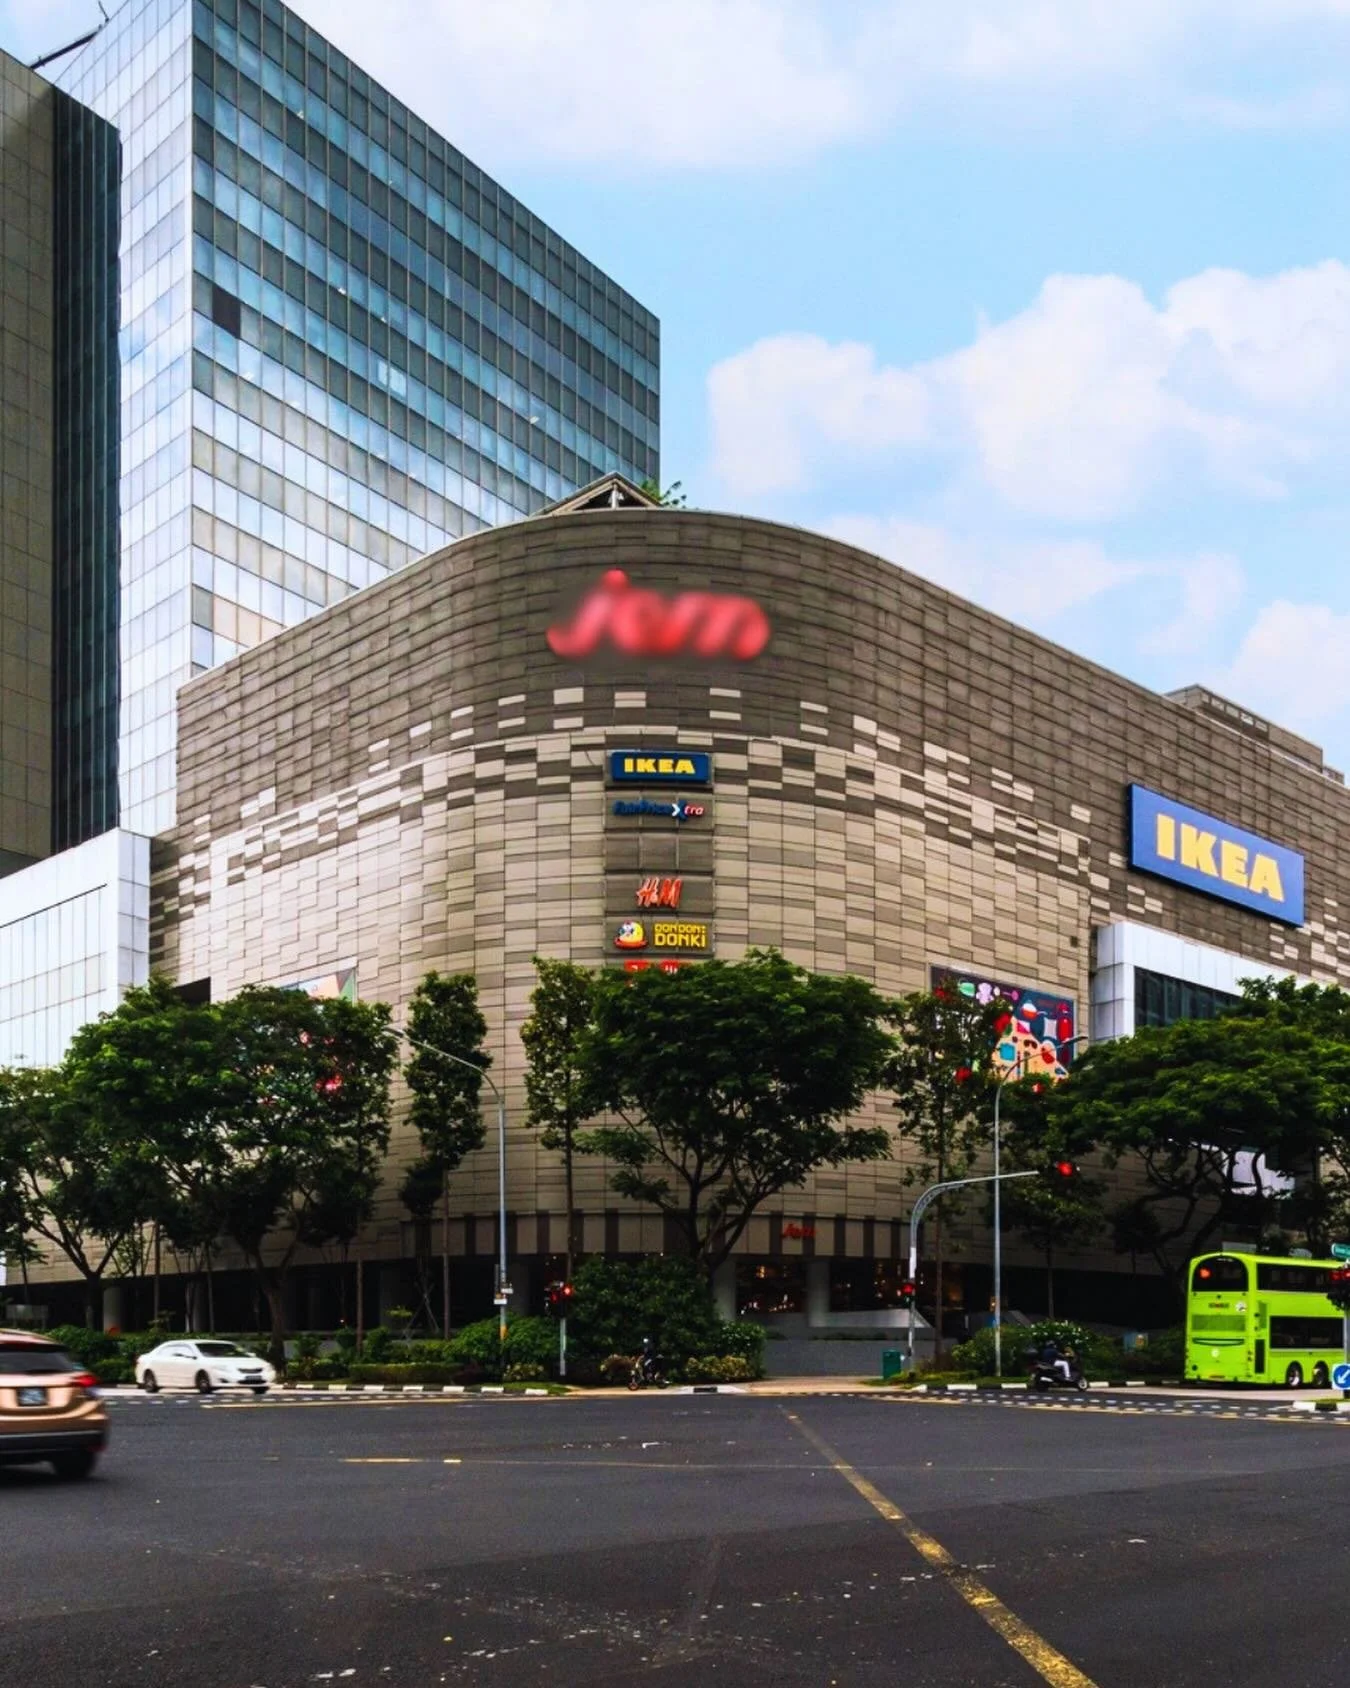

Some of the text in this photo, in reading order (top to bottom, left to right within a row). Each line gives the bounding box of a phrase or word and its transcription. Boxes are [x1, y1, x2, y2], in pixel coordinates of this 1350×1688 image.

[624, 758, 695, 774] IKEA
[1157, 814, 1284, 902] IKEA
[636, 876, 682, 908] H&M
[654, 934, 706, 947] DONKI
